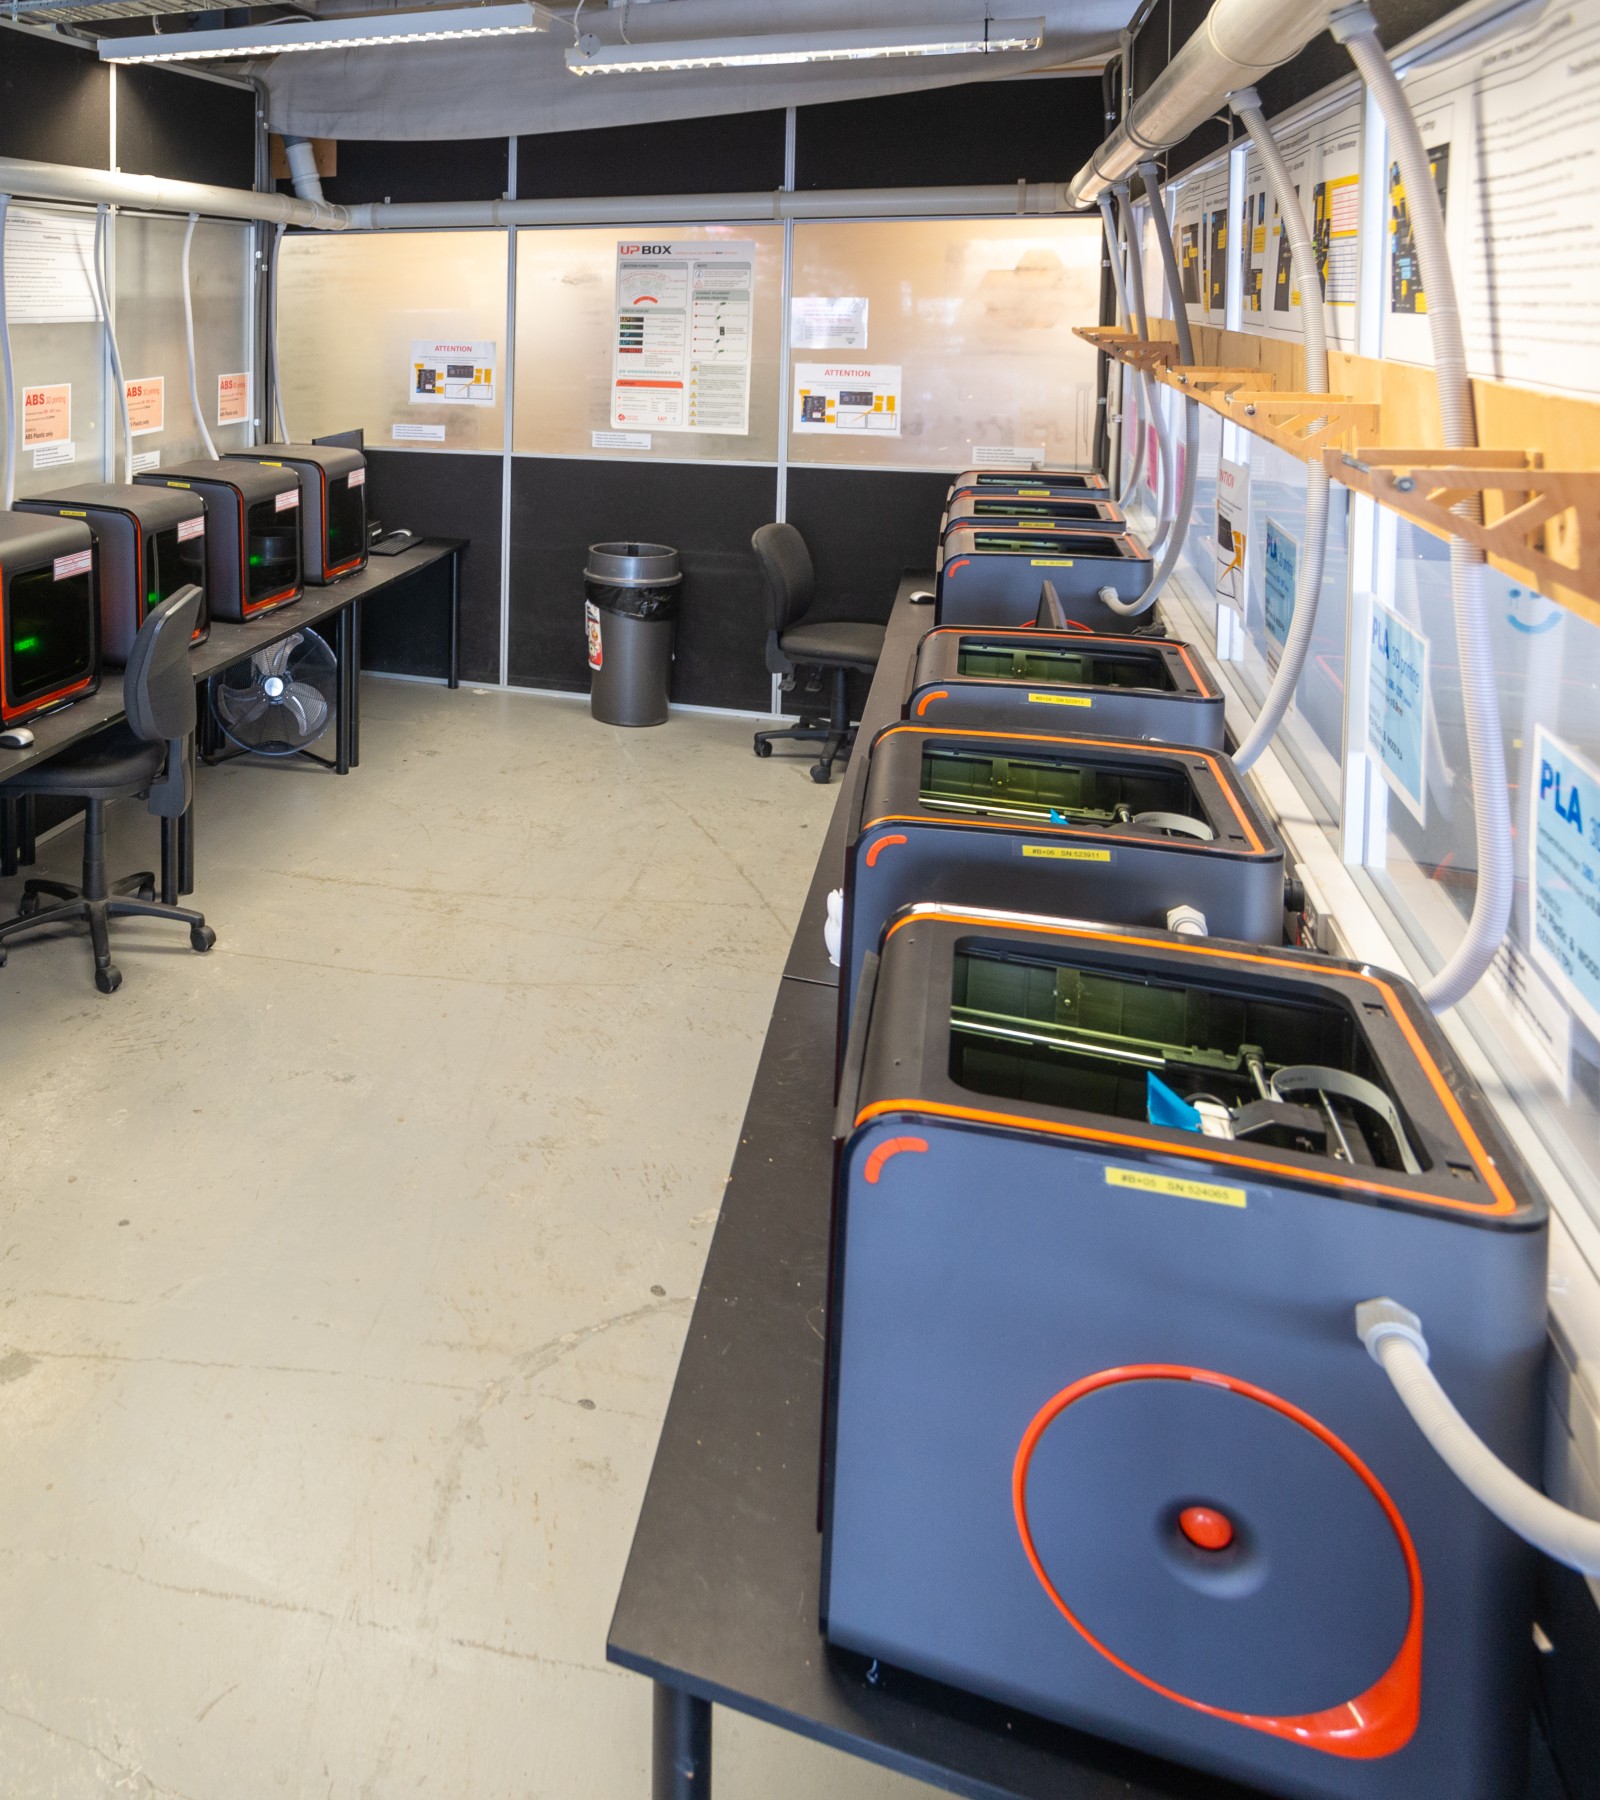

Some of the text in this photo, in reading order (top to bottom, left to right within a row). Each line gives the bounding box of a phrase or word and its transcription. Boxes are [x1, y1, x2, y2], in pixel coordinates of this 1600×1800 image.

[824, 369, 871, 377] ATTENTION
[220, 380, 233, 390] ABS
[126, 386, 142, 398] ABS
[25, 393, 45, 407] ABS
[1267, 532, 1278, 560] PLA
[1372, 616, 1390, 661] PLA
[1540, 758, 1583, 834] PLA
[1167, 1181, 1184, 1192] SN
